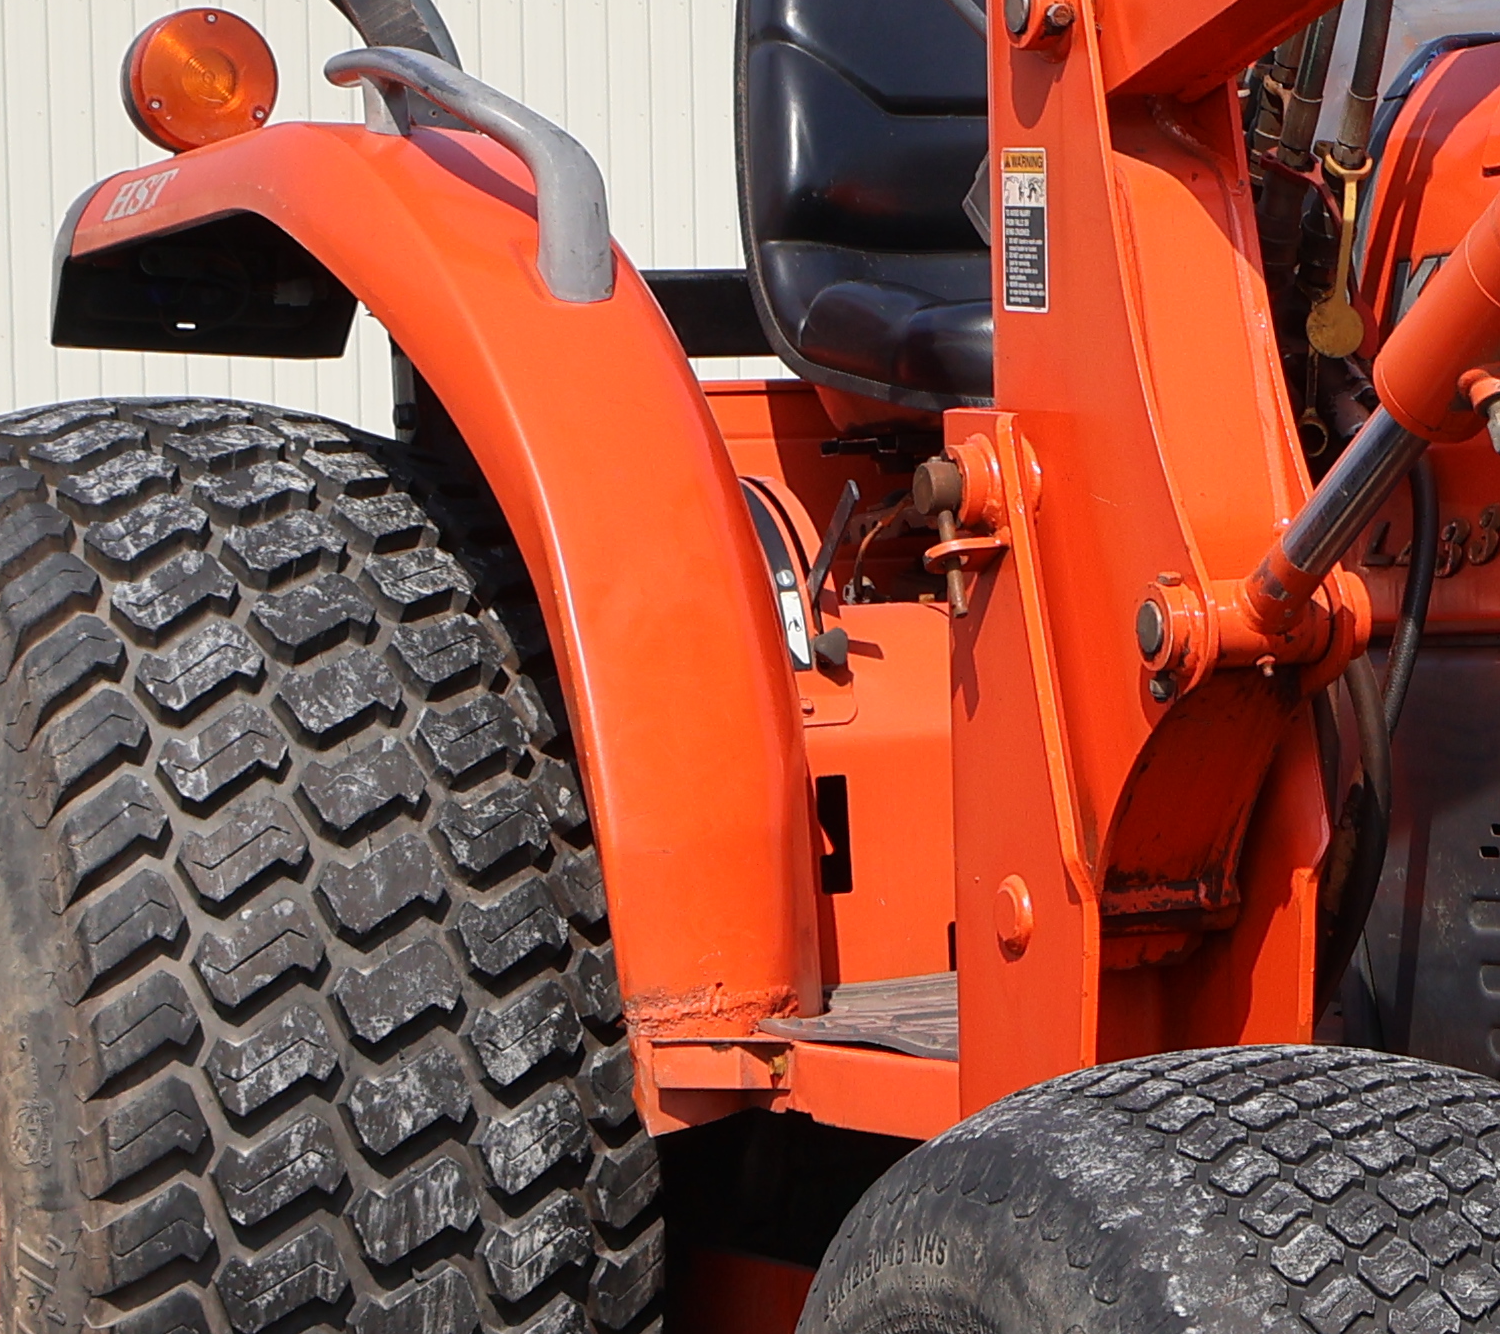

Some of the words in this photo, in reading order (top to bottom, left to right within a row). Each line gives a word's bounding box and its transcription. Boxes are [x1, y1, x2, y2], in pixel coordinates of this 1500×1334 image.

[1012, 155, 1043, 169] WARNING
[103, 167, 180, 222] HST
[911, 1231, 949, 1267] NHS
